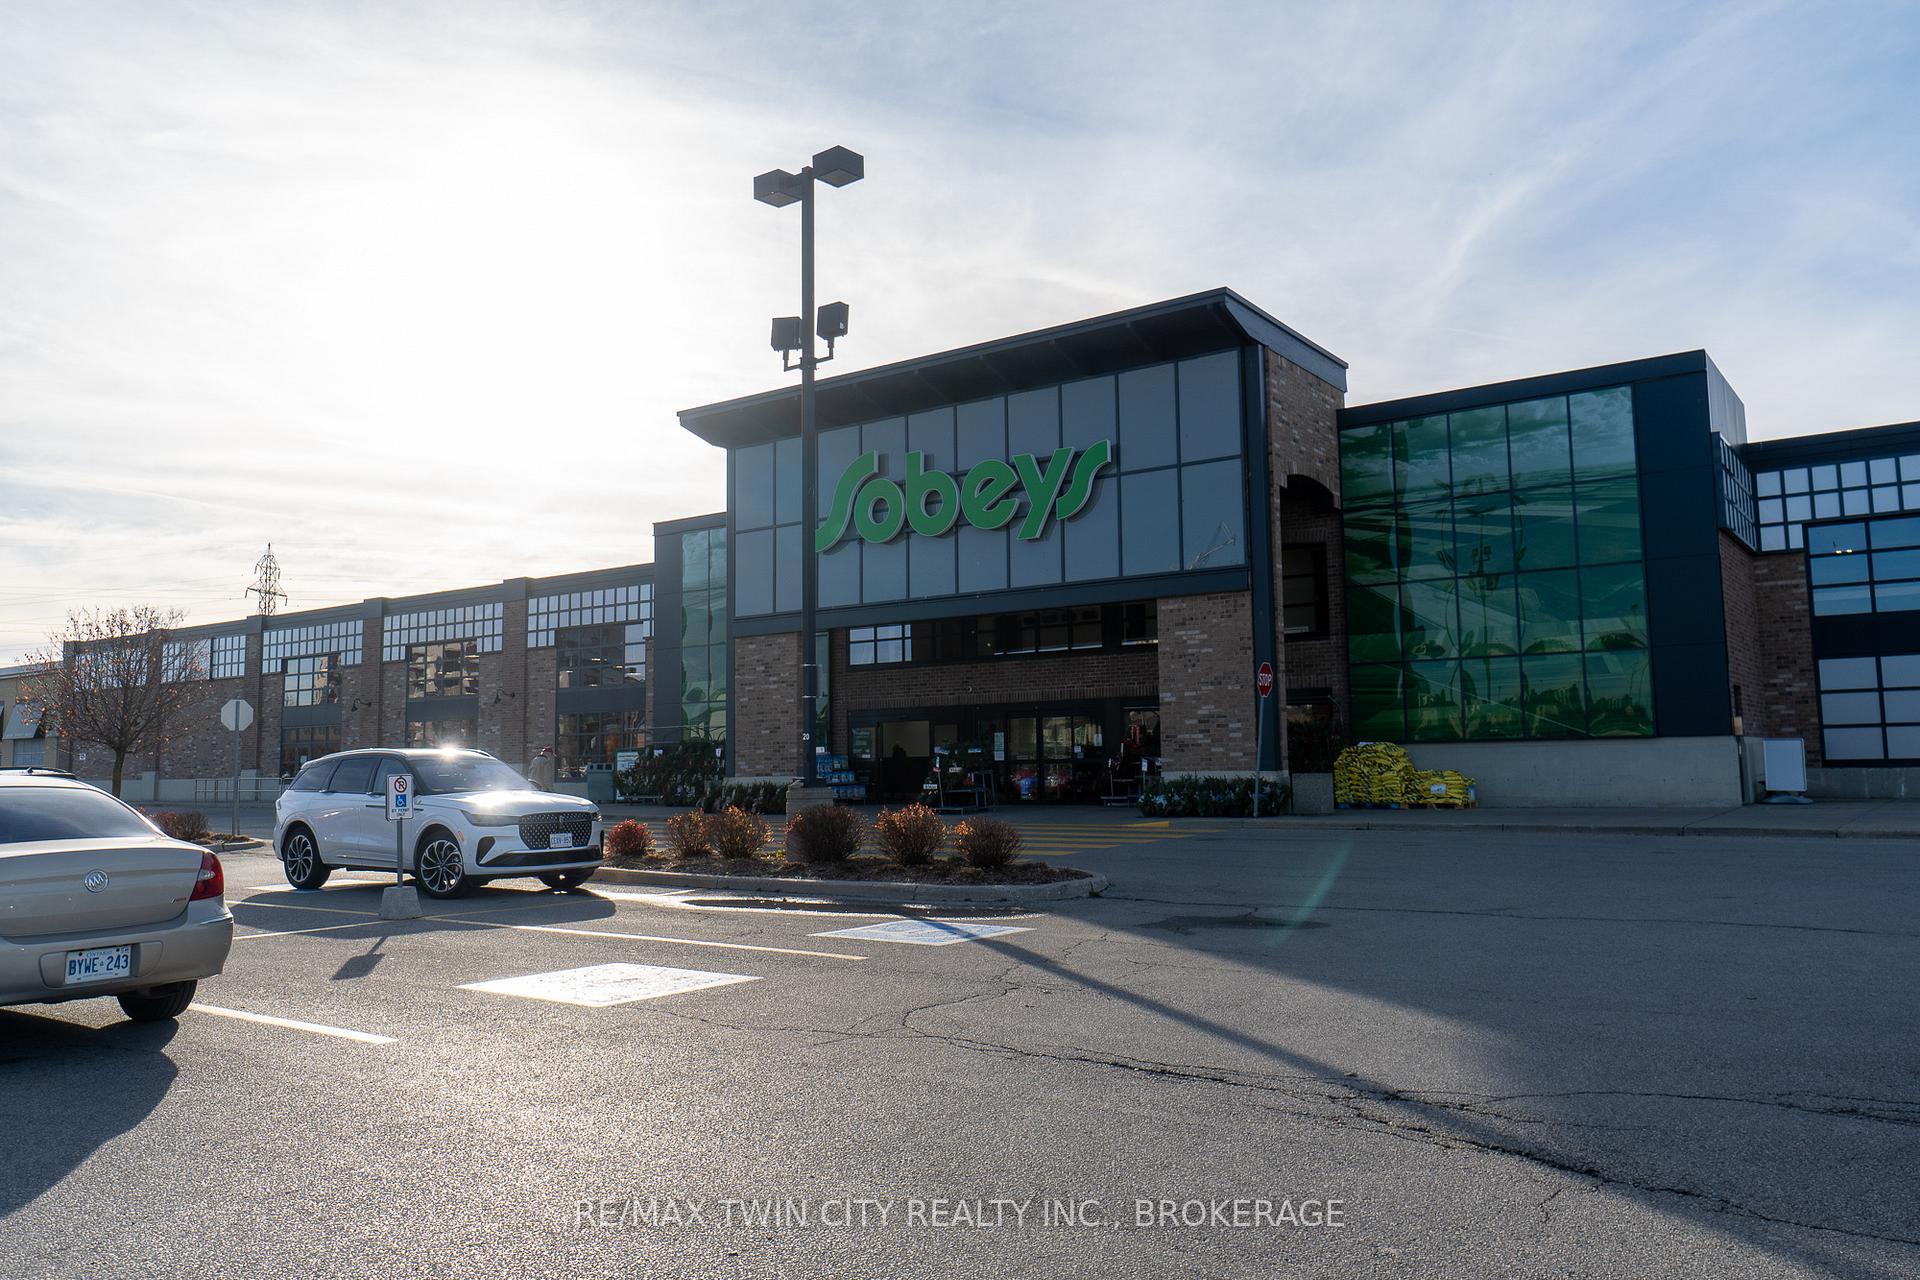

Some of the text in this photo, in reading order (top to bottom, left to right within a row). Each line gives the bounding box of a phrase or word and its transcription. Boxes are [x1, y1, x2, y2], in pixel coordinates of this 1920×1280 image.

[815, 439, 1111, 552] Sobeys
[1259, 673, 1272, 687] STOP
[802, 732, 810, 740] 20
